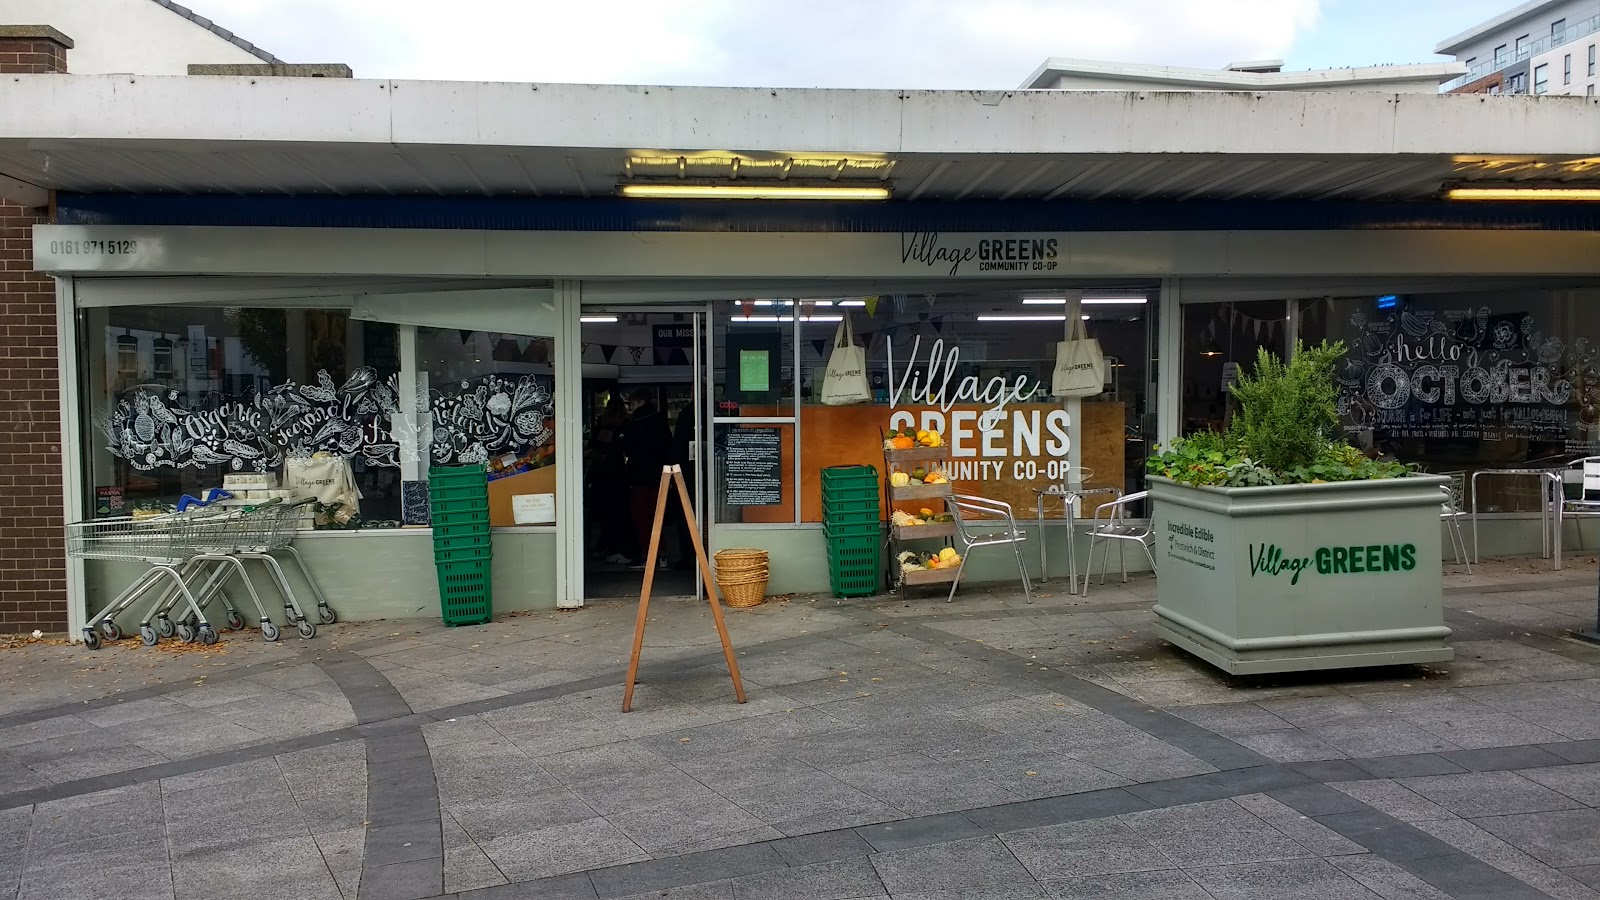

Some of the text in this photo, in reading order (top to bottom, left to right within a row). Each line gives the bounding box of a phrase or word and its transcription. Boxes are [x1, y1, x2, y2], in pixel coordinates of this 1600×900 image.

[50, 240, 137, 255] 0161 971 5129
[901, 232, 1058, 276] Village GREENS
[979, 261, 1058, 271] COMMUNITY CO-OP
[658, 327, 706, 338] OUR MISSN
[1392, 333, 1464, 362] hello
[886, 334, 1041, 432] Village
[1365, 361, 1571, 410] OCTOBER
[1376, 409, 1406, 423] SQUASH
[1013, 460, 1071, 480] CO-OP
[1167, 520, 1214, 543] Incredible Edible
[1249, 543, 1313, 586] Village
[1315, 543, 1416, 575] GREENS
